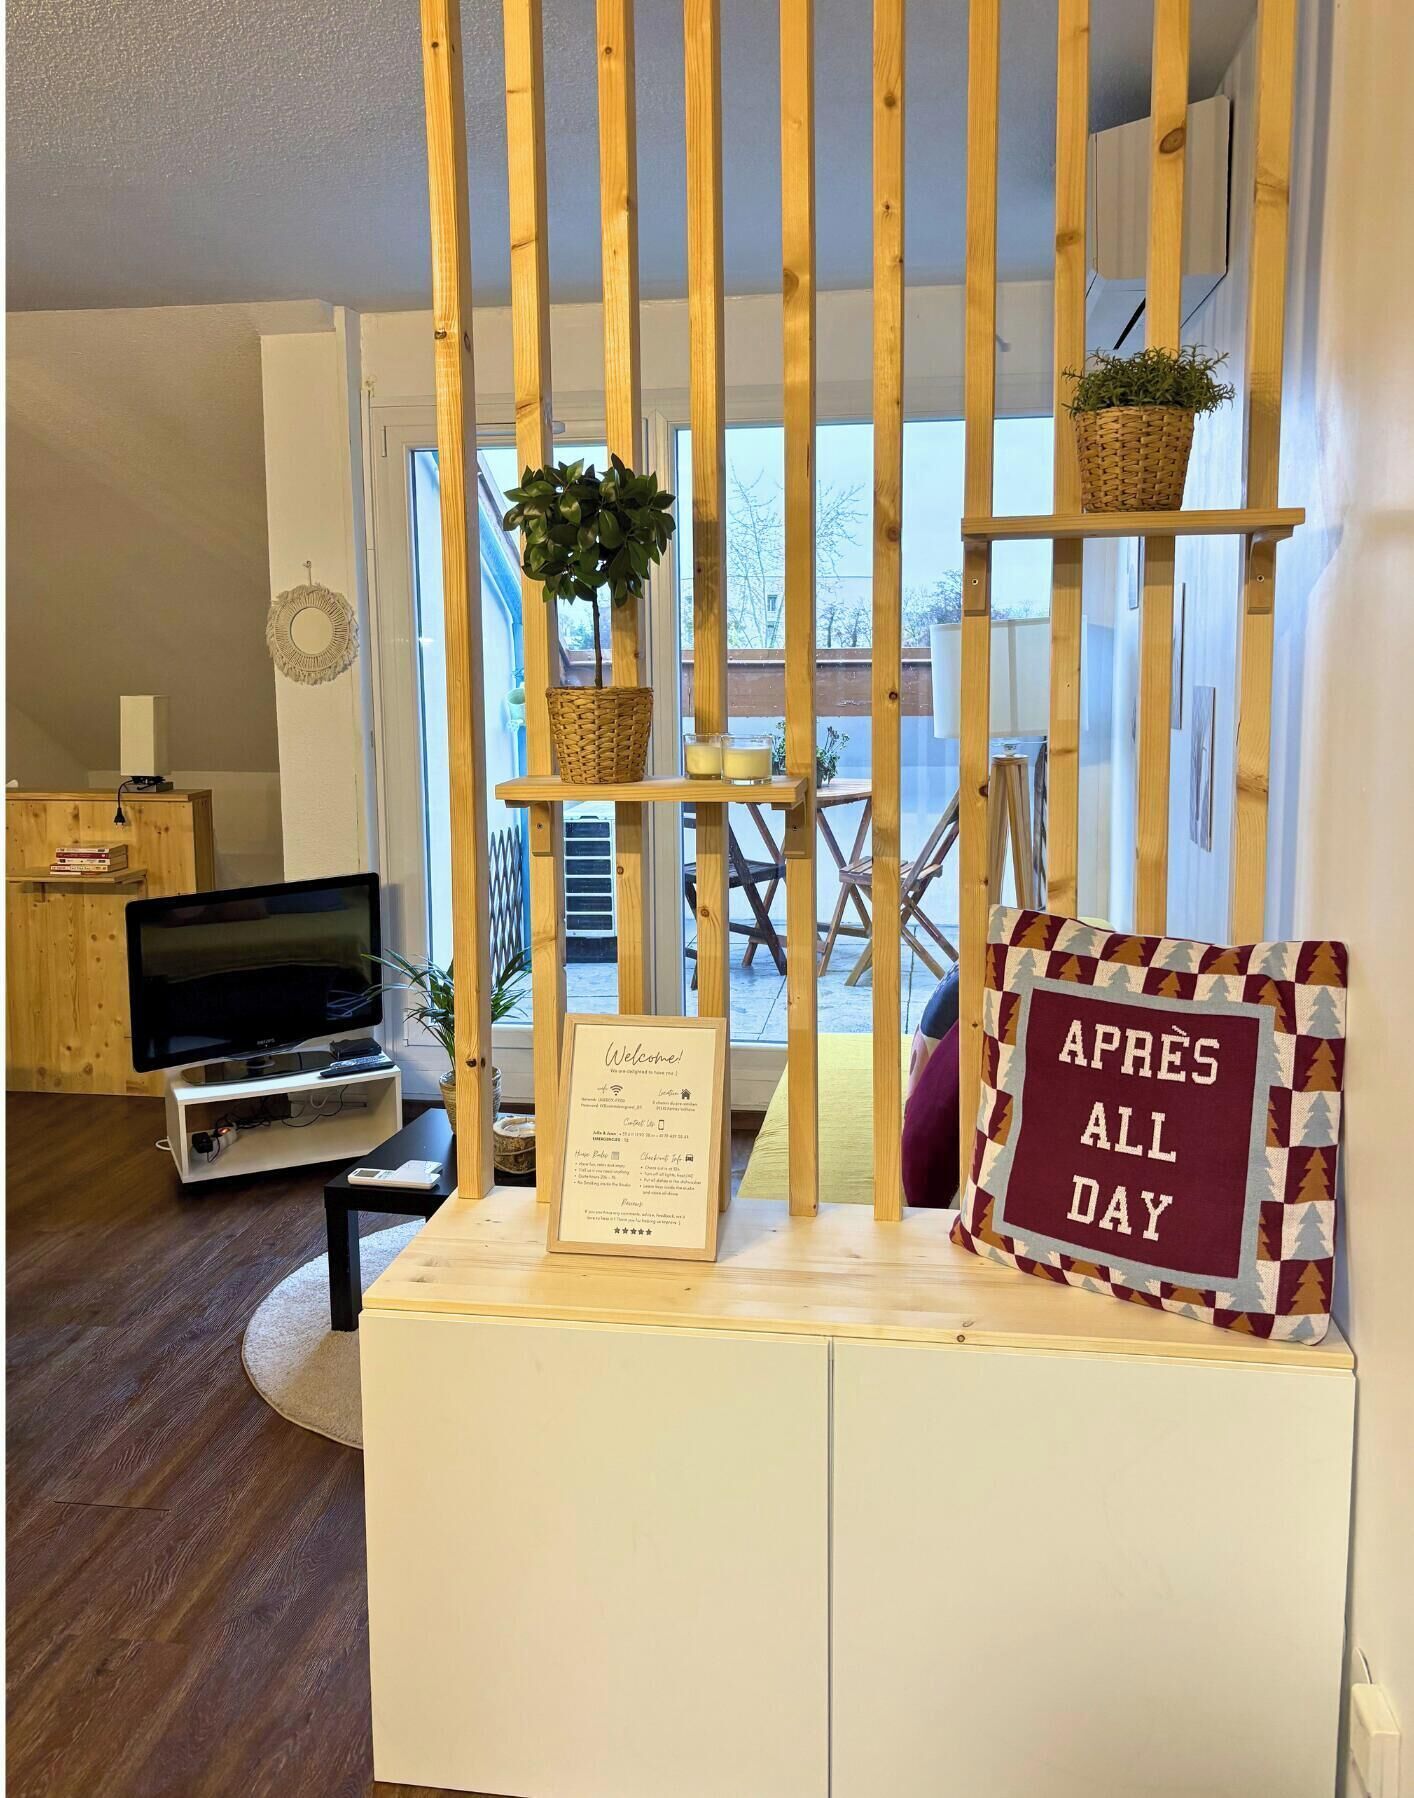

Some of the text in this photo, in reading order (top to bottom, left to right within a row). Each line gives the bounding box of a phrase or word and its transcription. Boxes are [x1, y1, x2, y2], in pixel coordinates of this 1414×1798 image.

[605, 1041, 684, 1066] Welcome!
[1058, 1018, 1220, 1085] APRÈS
[623, 1117, 644, 1127] Contact
[1080, 1101, 1176, 1163] ALL
[1066, 1174, 1174, 1241] DAY
